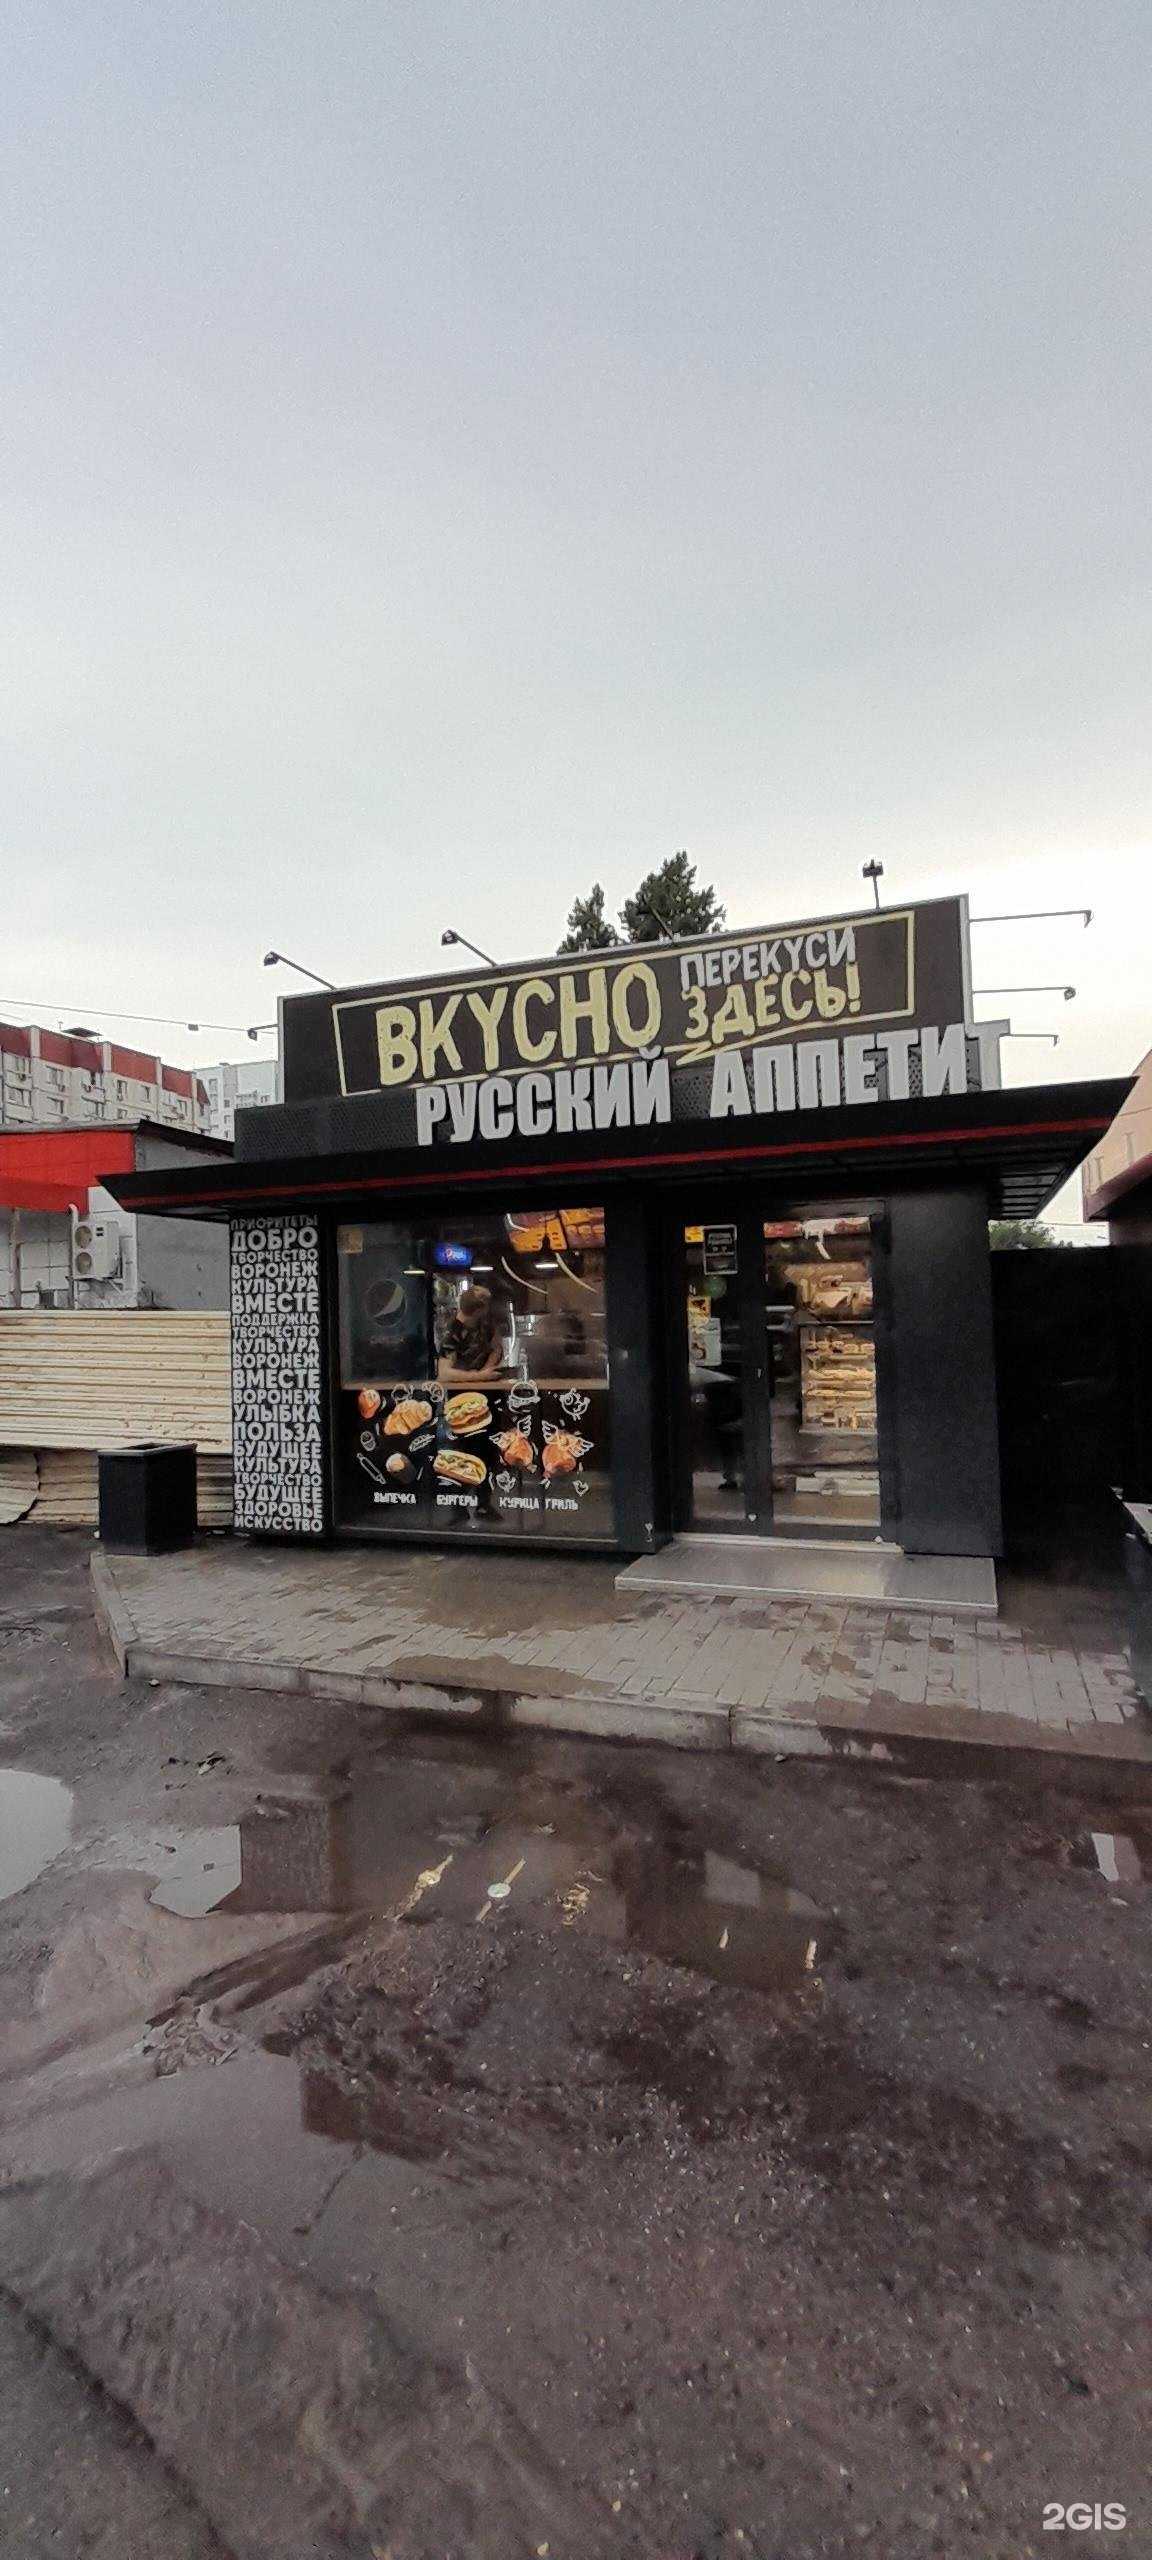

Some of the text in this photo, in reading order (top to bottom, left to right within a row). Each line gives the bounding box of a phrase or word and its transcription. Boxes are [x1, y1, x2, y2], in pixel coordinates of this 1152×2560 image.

[680, 926, 856, 990] ПЕРЕКУСИ
[681, 962, 861, 1043] ЗДЕСЬ!
[375, 962, 662, 1086] ВКУСНО
[416, 1019, 1010, 1145] РУССКИЙ АППЕТИТ
[232, 1226, 318, 1251] ДОБРО
[232, 1249, 318, 1263] ТВОРЧЕСТВО
[231, 1261, 318, 1279] ВОРОНЕЖ
[232, 1276, 318, 1294] КУЛЬТУРА
[231, 1292, 319, 1314] ВМЕСТЕ
[232, 1312, 319, 1326] ПОДДЕРЖКА
[232, 1325, 319, 1338] ТВОРЧЕСТВО
[232, 1337, 319, 1353] КУЛЬТУРА
[232, 1352, 319, 1369] ВОРОНЕЖ
[232, 1368, 320, 1388] ВМЕСТЕ
[233, 1389, 320, 1404] ВОРОНЕЖ
[233, 1404, 321, 1422] УЛЫБКА
[234, 1422, 321, 1441] ПОЛЬЗА
[234, 1440, 321, 1459] БУДУЩЕЕ
[234, 1457, 321, 1474] КУЛЬТУРА
[234, 1472, 322, 1486] ТВОРЧЕСТВО
[234, 1484, 322, 1503] БУДУЩЕЕ
[374, 1492, 416, 1504] ВЫПЕЧКА
[437, 1494, 478, 1507] БУРГЕРЫ
[234, 1501, 322, 1519] ЗДОРОВЬЕ
[545, 1498, 579, 1511] ГРИЛЬ
[234, 1516, 323, 1532] ИСКУССТВО
